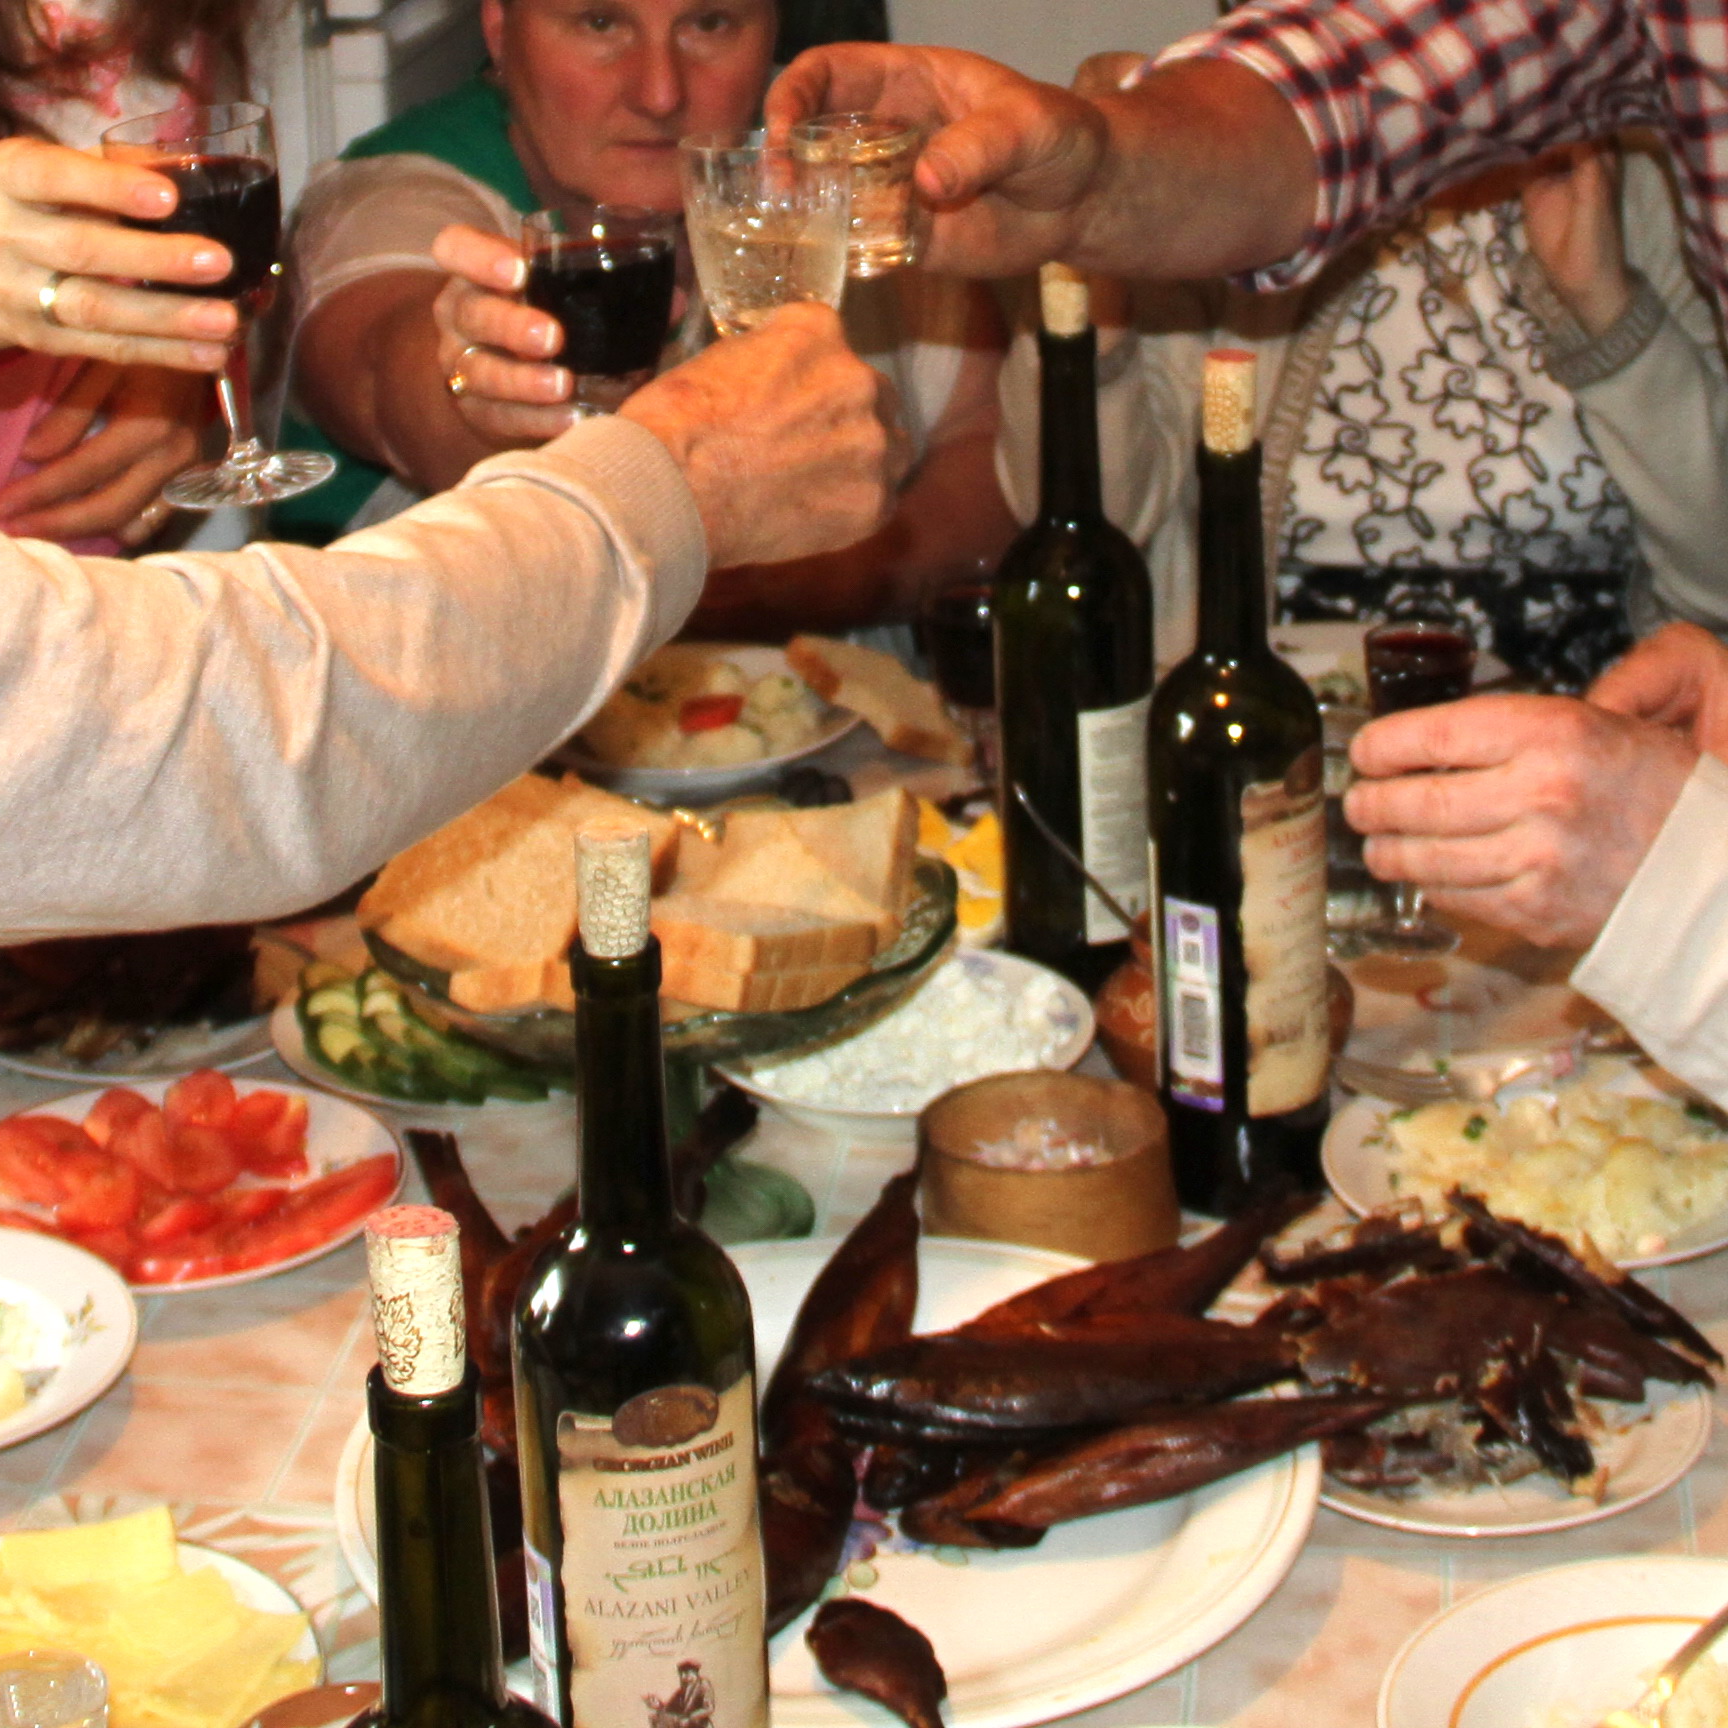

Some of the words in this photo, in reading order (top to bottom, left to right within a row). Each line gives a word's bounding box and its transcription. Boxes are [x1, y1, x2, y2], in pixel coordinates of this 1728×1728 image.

[592, 1462, 736, 1509] АЛАЗАНСКАЯ
[622, 1499, 718, 1537] ДОЛИНА
[584, 1597, 678, 1619] ALAZANI
[686, 1568, 751, 1610] VALLEY
